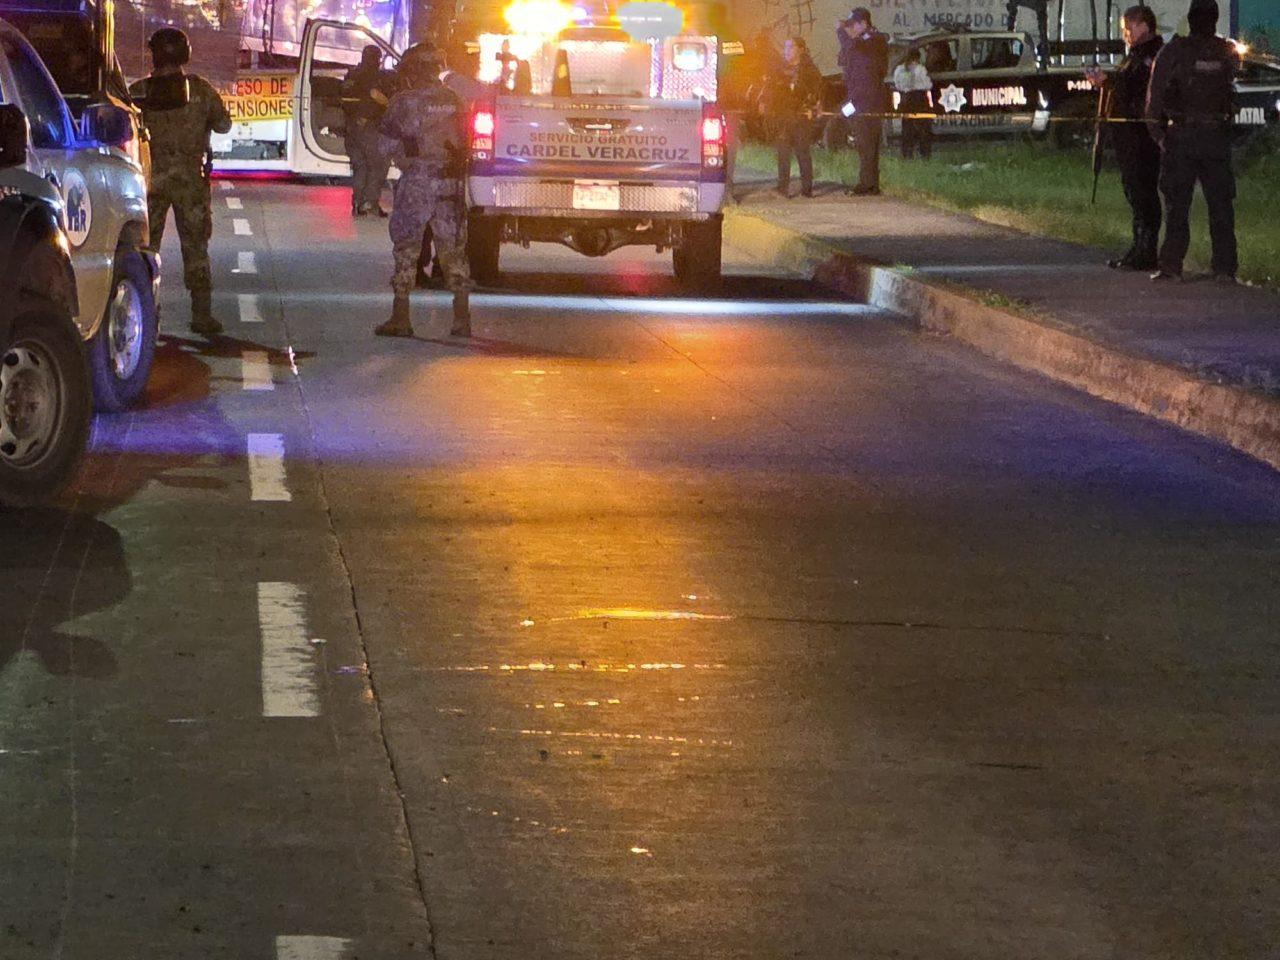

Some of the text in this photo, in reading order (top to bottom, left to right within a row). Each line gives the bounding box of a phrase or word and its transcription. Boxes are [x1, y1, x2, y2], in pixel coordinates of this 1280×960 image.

[894, 12, 910, 26] AL
[924, 12, 993, 28] MERCADO
[234, 77, 288, 97] ESO DE
[972, 86, 1027, 106] MUNICIPAL
[227, 99, 293, 118] ENSIONES
[530, 132, 668, 146] SERVICIO GRATUITO
[506, 144, 690, 161] CARDEL VERACRUZ
